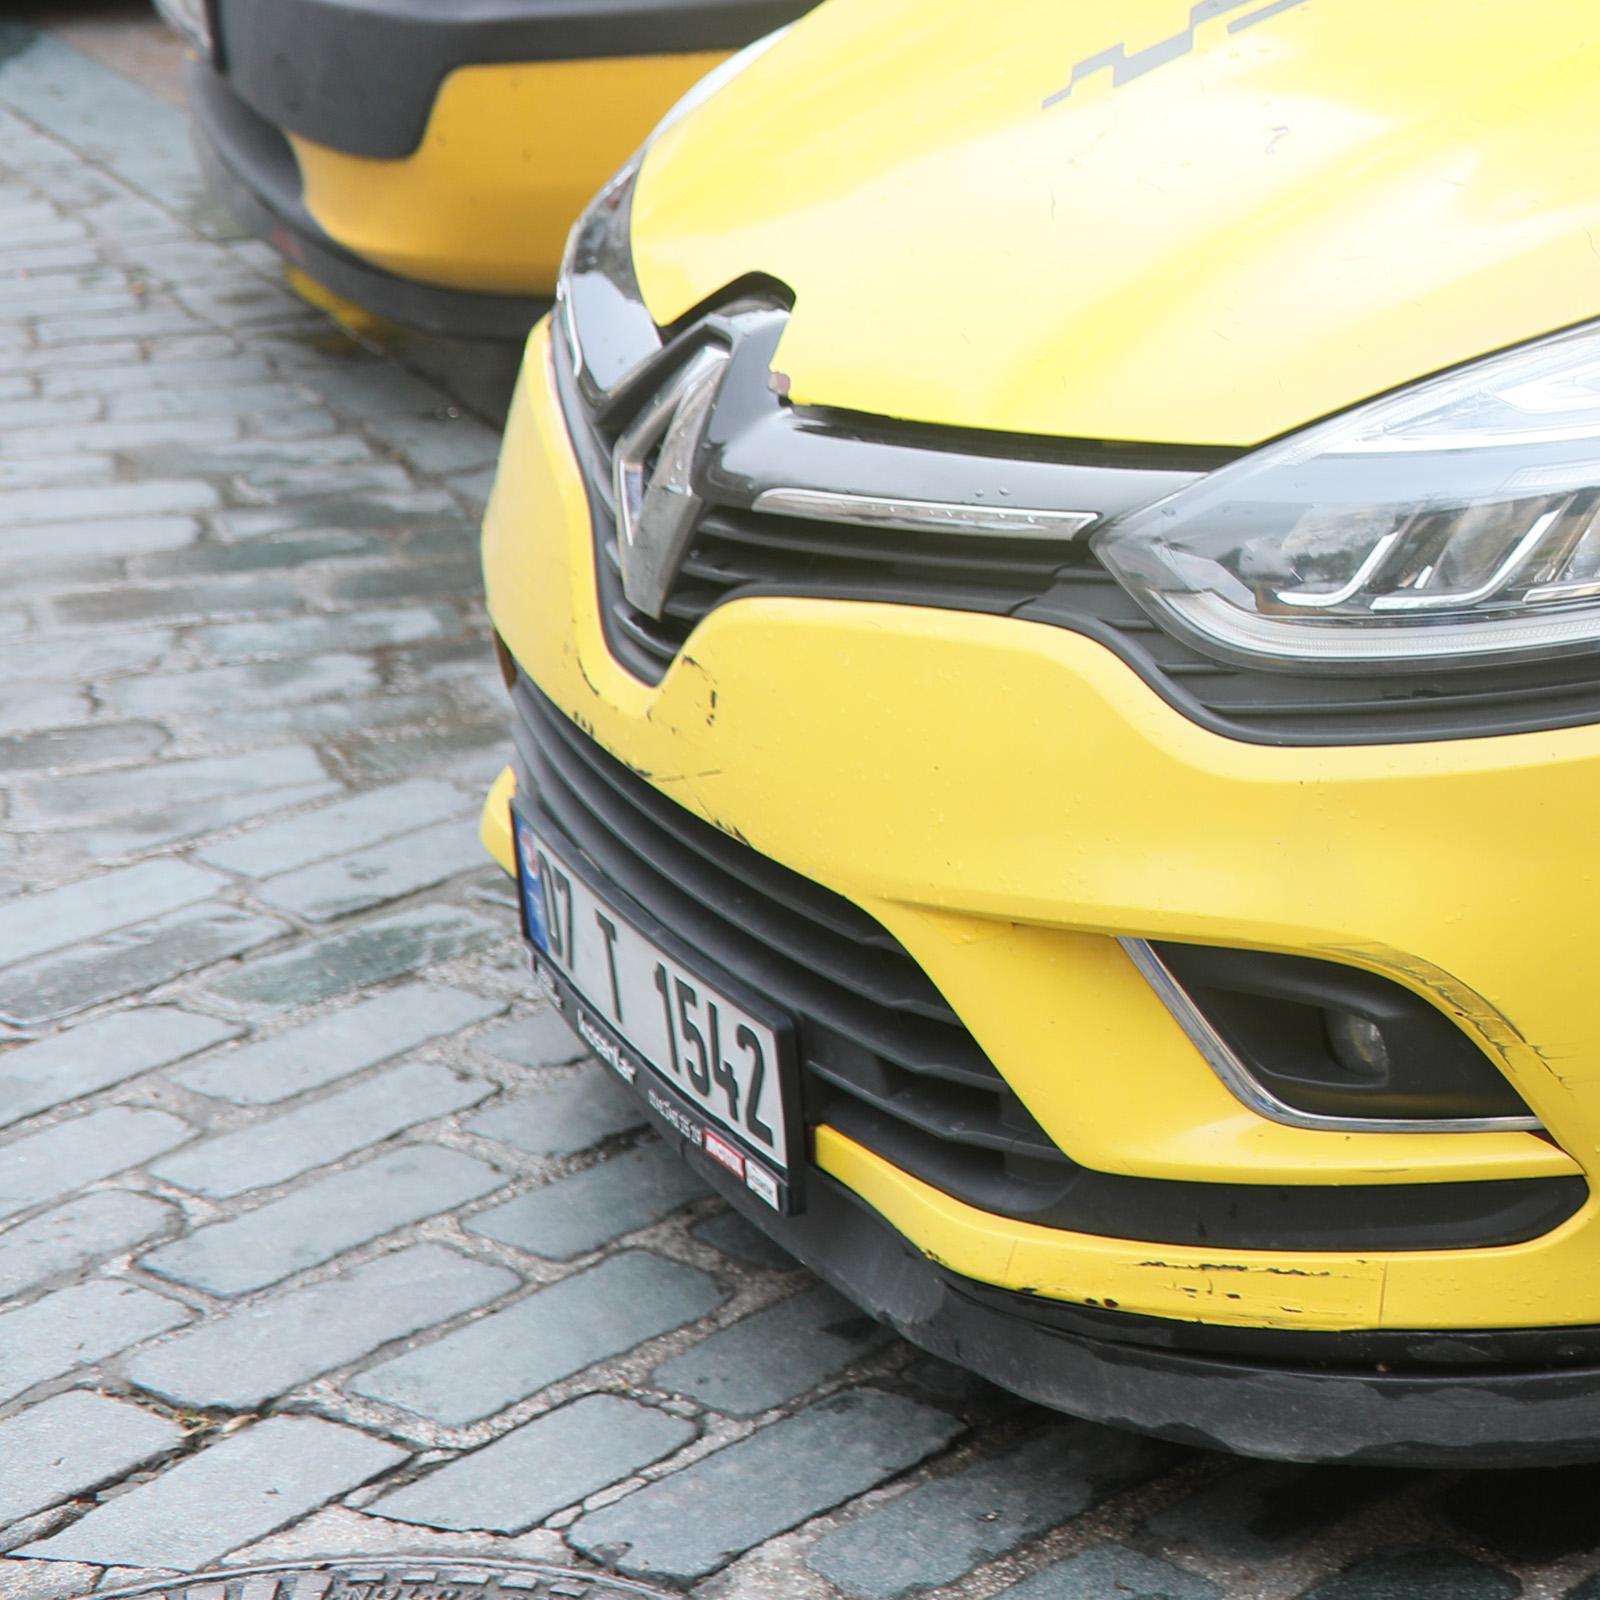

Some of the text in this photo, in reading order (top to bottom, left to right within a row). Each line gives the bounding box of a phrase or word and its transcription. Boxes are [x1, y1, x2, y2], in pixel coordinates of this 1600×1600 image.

[538, 849, 574, 971] 07
[597, 911, 623, 1023] T
[654, 962, 775, 1147] 1542
